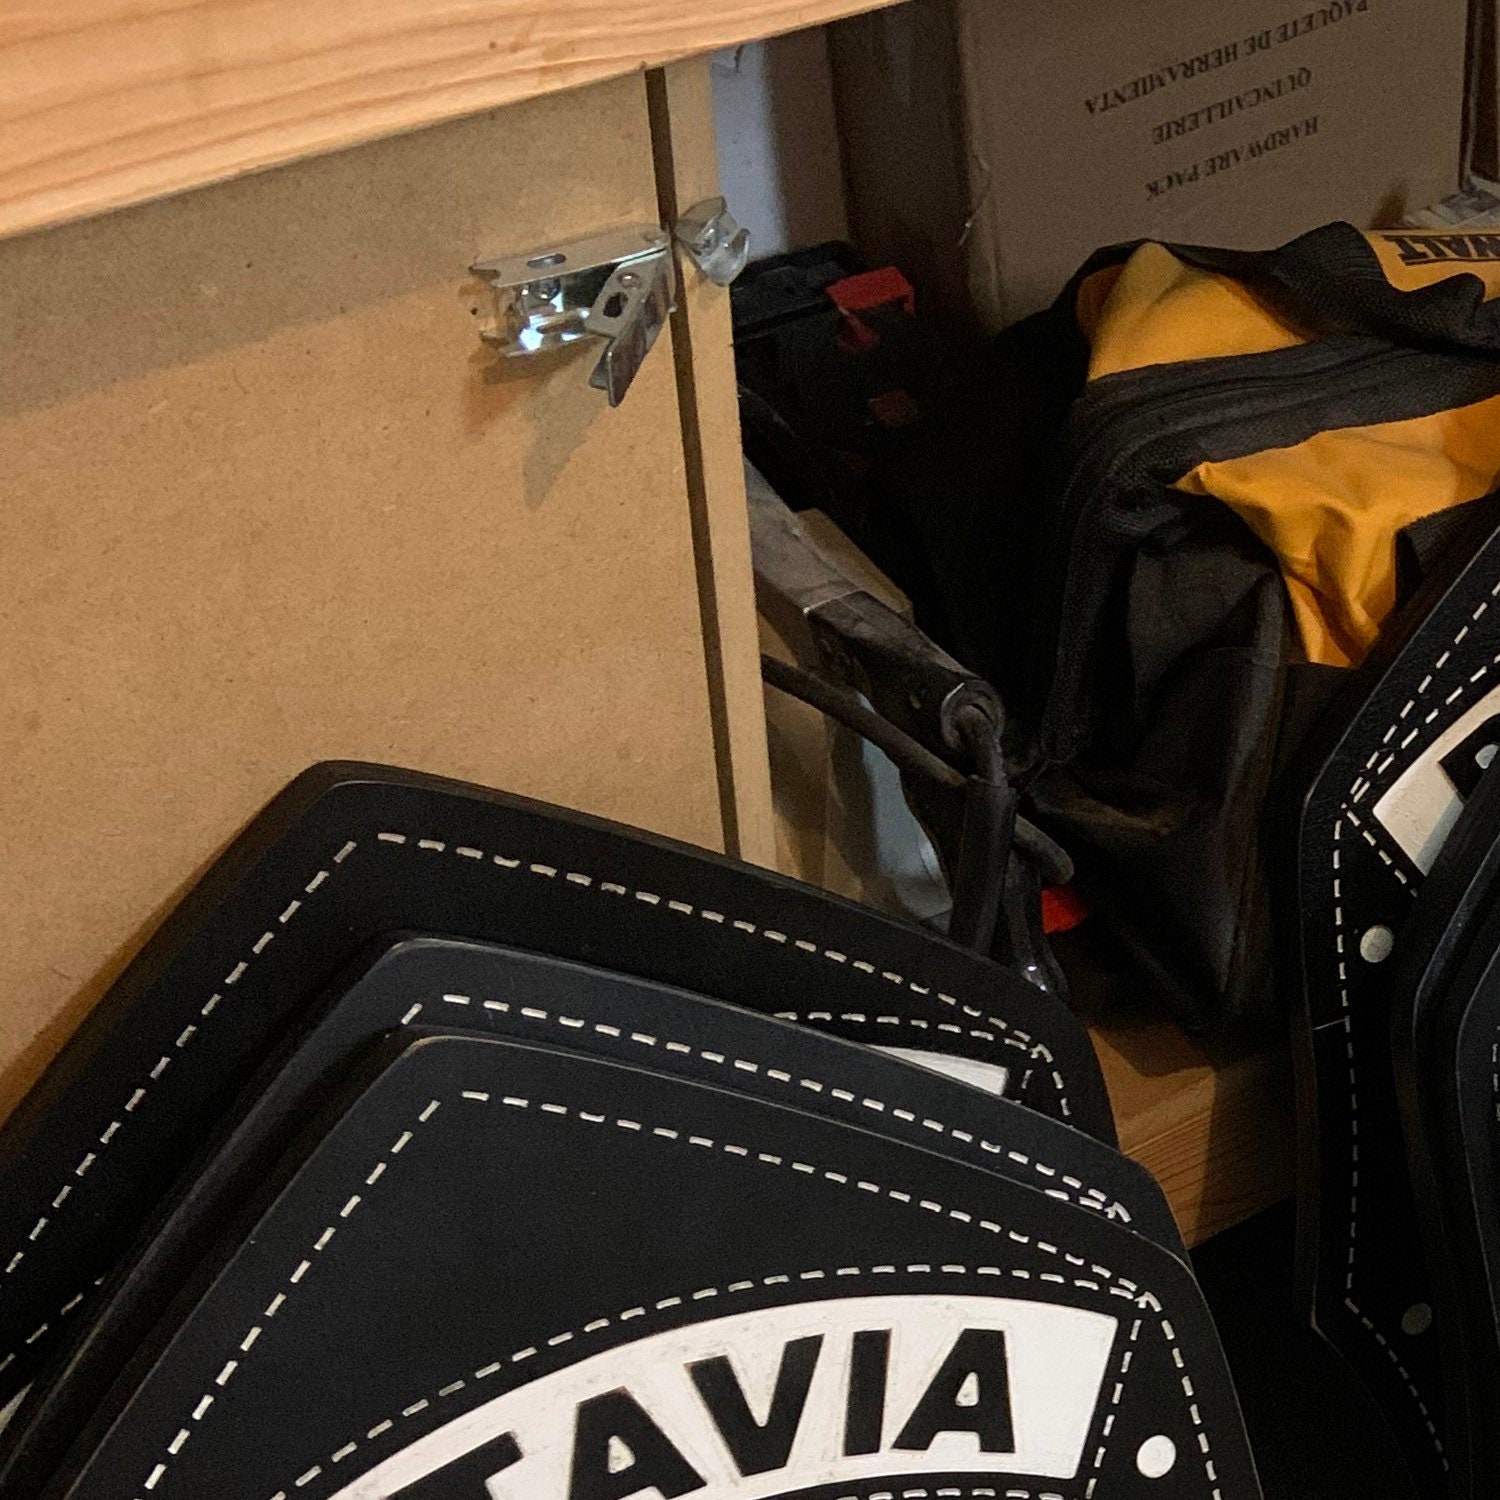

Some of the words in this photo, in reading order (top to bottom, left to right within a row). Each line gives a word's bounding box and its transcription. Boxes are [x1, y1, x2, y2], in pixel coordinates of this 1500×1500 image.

[1246, 30, 1272, 56] DE
[1085, 42, 1239, 115] HERRAMIENTA
[1153, 66, 1313, 145] QUINCAILLERIE
[1206, 115, 1321, 177] HARDWARE
[1145, 163, 1200, 200] PACK
